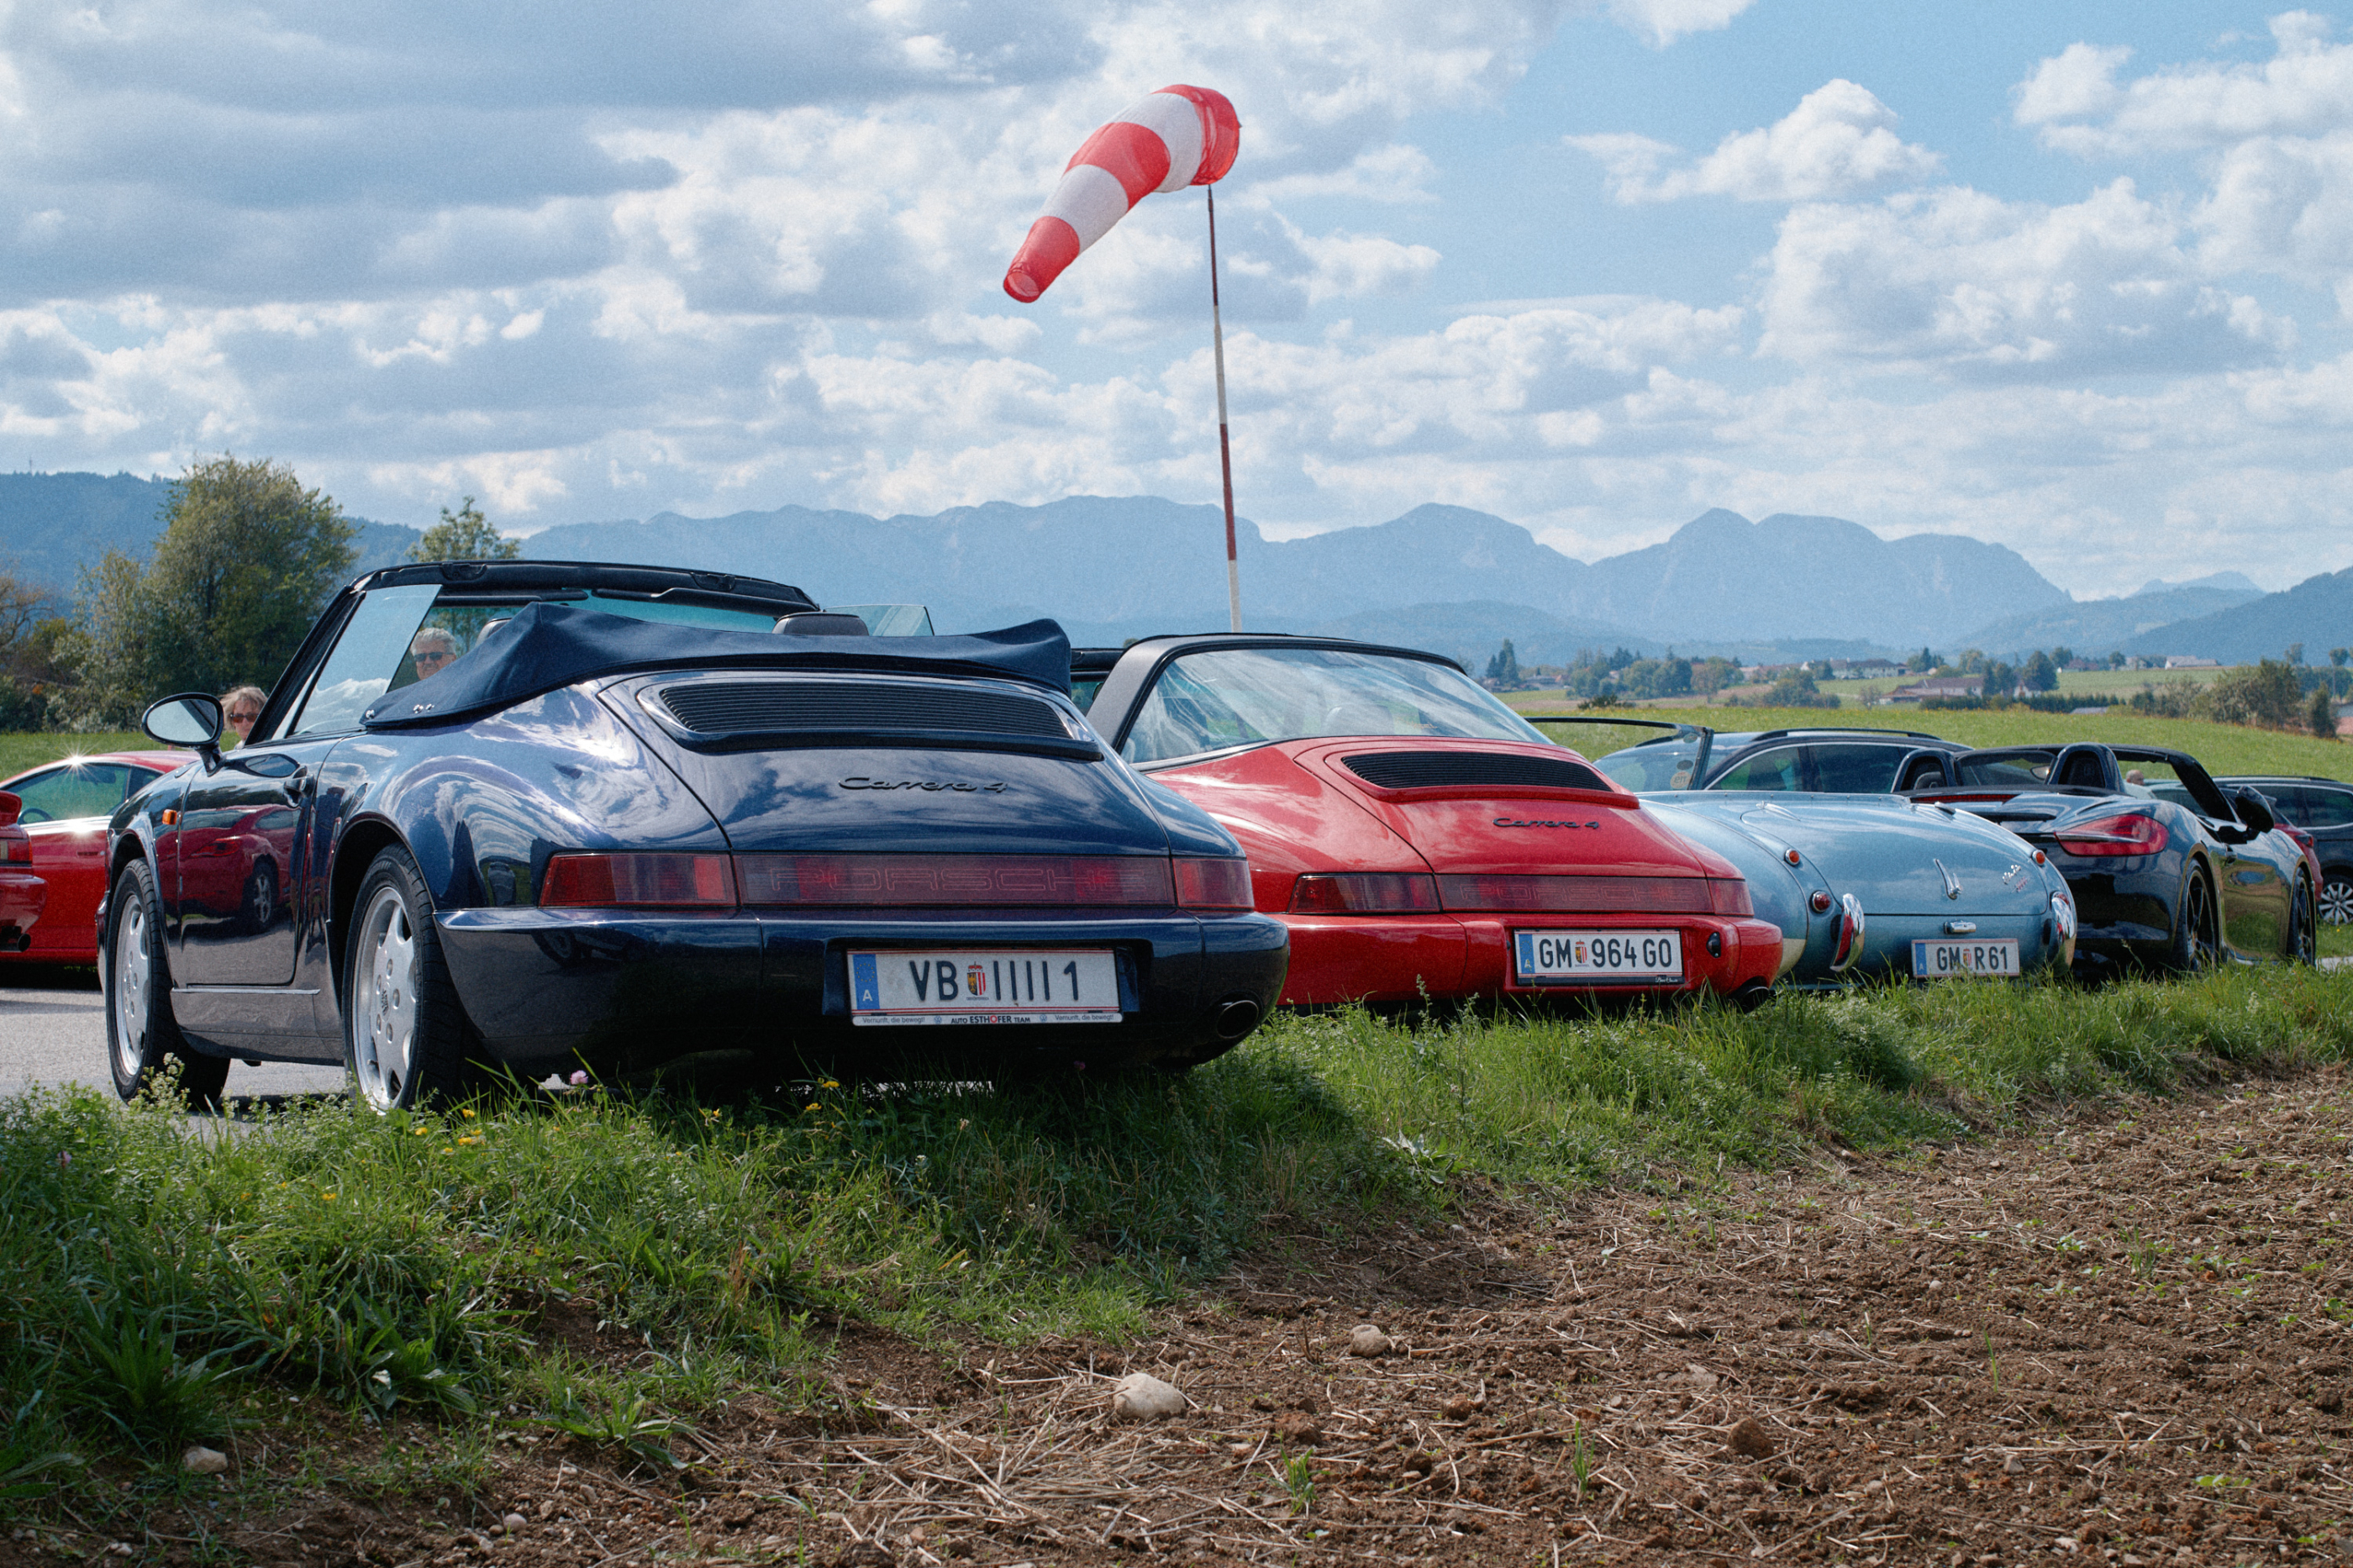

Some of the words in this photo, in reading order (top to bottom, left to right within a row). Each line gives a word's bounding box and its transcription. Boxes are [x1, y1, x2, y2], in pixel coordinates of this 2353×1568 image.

[839, 777, 977, 792] Carrera
[984, 782, 1008, 793] 4
[1492, 818, 1581, 829] Carrera
[1584, 821, 1599, 829] 4
[770, 868, 1147, 892] PORSCHE
[1459, 884, 1696, 903] PORSCHE
[1539, 939, 1572, 968] GM
[1936, 946, 1961, 971] GM
[909, 960, 959, 1001] VB
[862, 989, 873, 1002] A
[970, 1015, 1013, 1023] ESTHOFER
